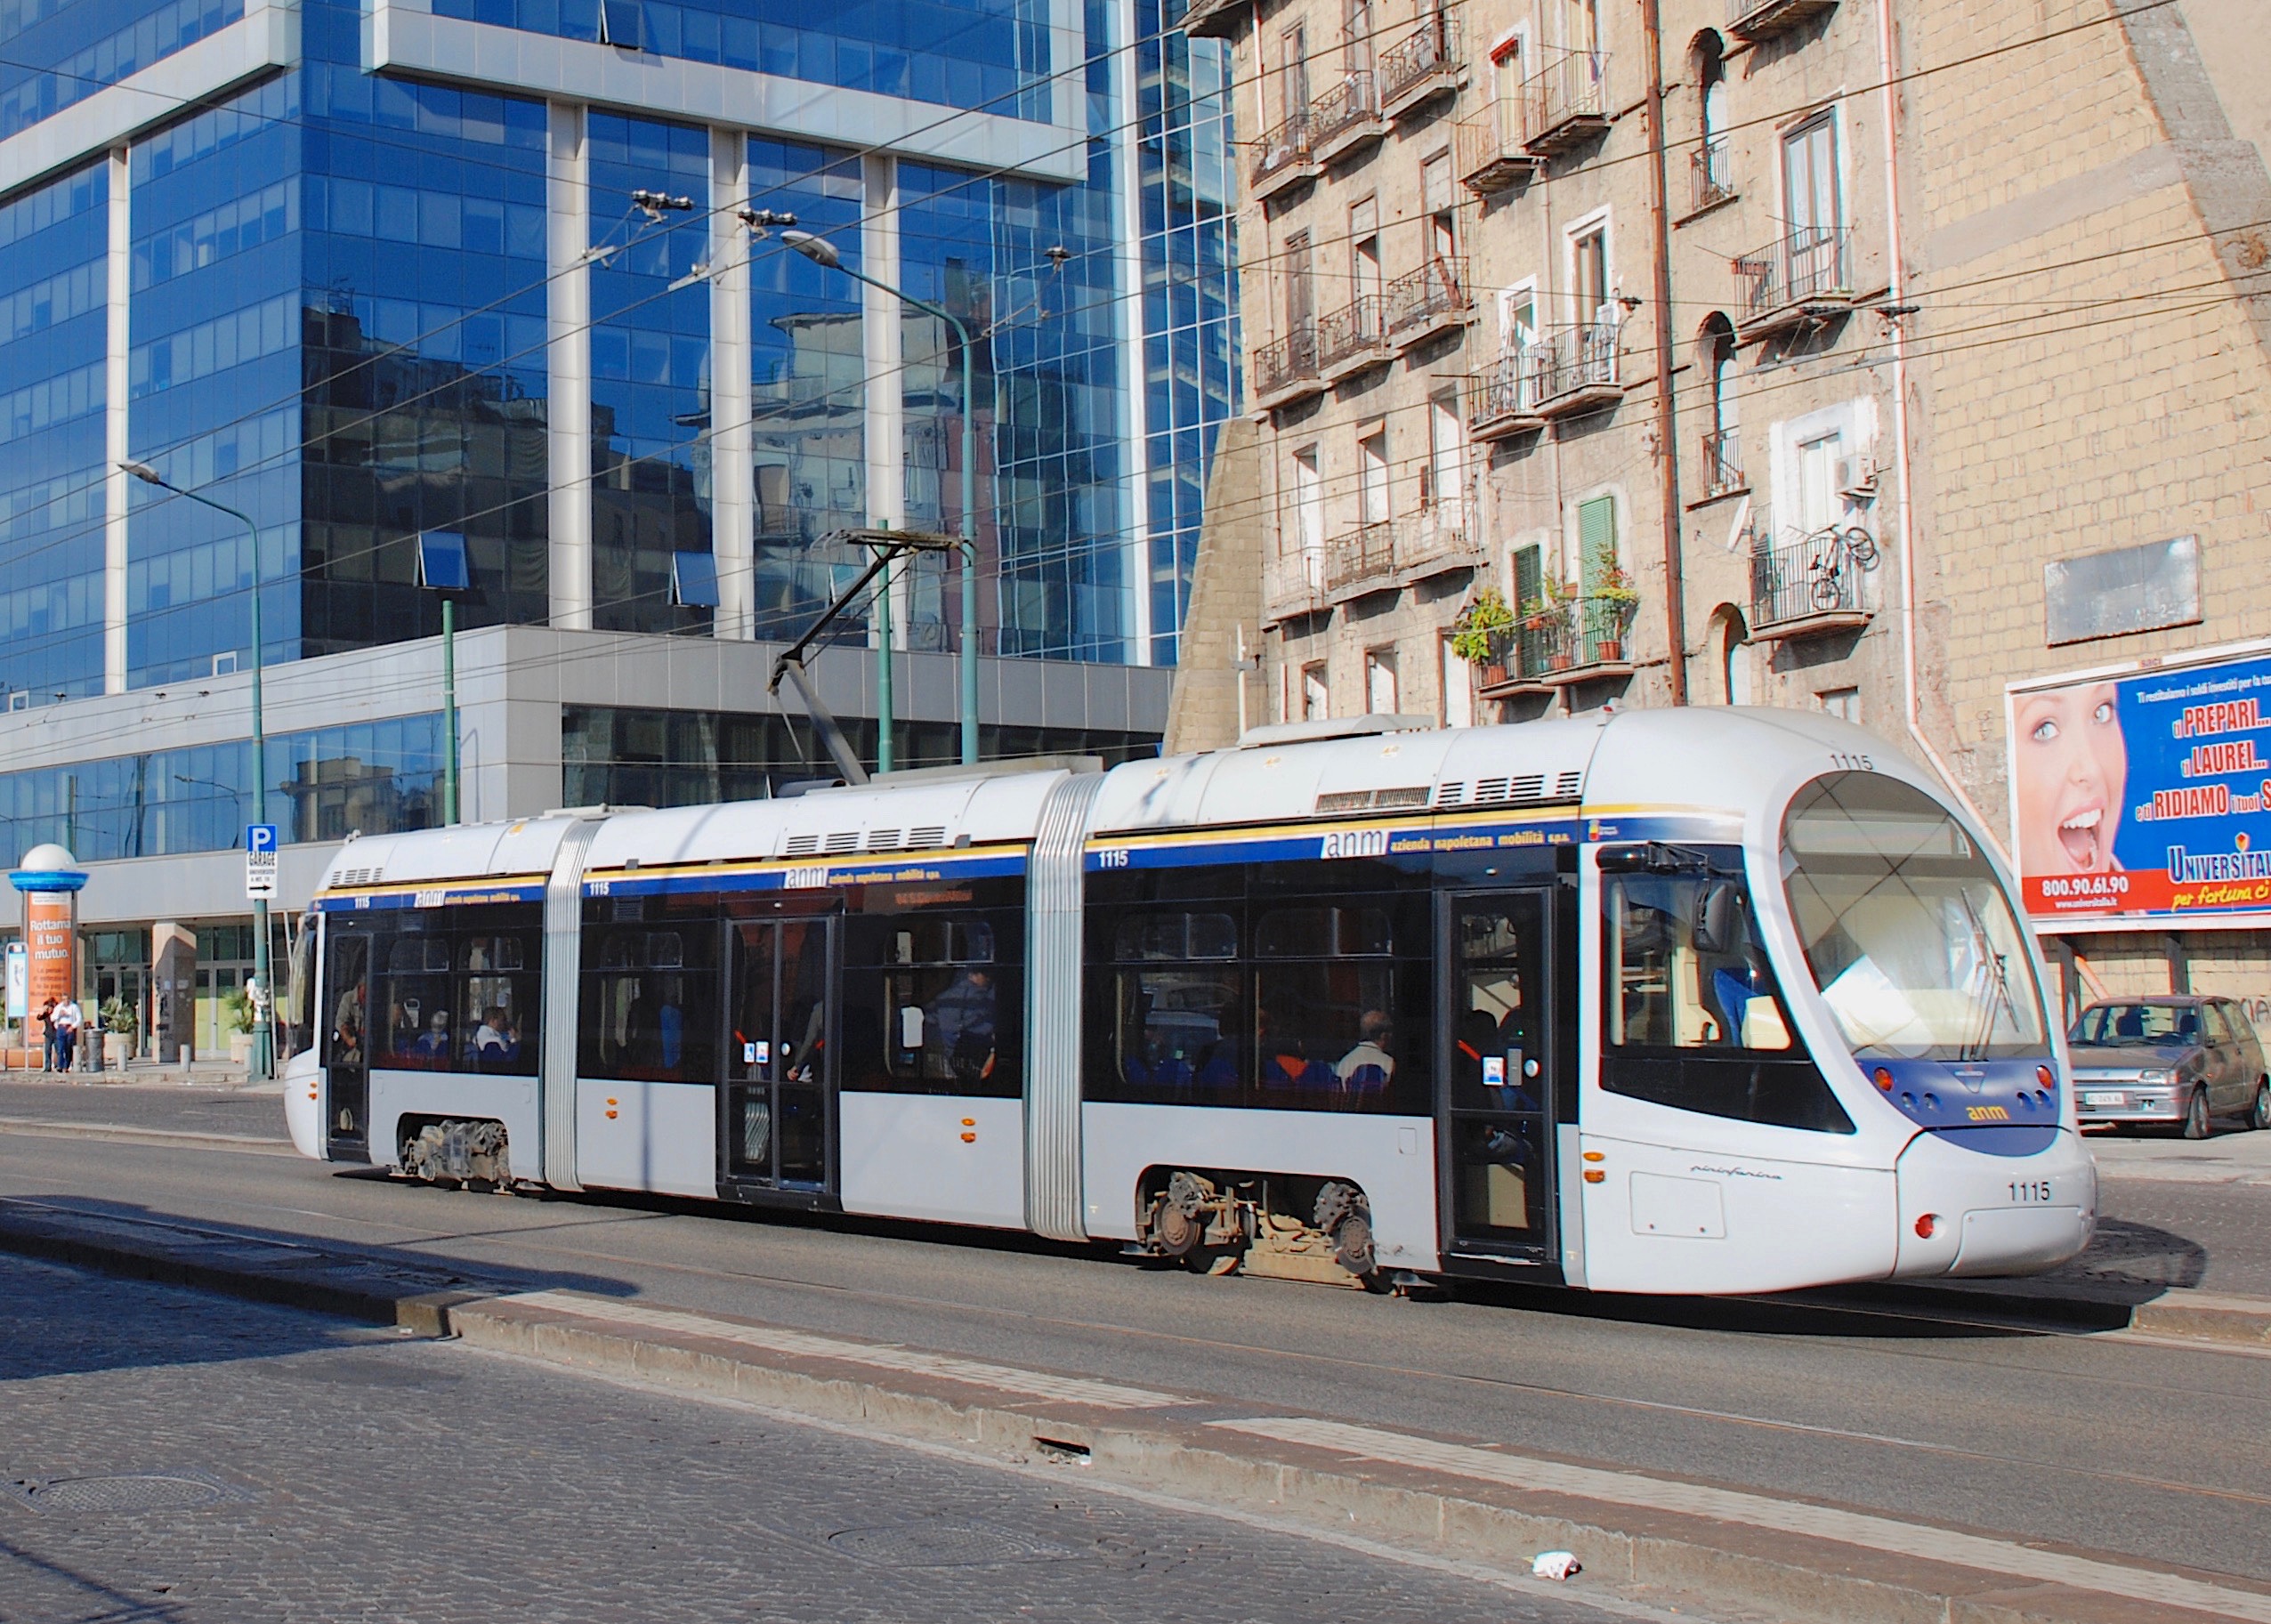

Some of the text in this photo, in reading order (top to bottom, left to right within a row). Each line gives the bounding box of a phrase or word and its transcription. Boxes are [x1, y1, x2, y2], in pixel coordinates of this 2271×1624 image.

[2183, 698, 2271, 737] PREPARI...
[1830, 753, 1873, 771] 1115
[2191, 740, 2268, 777] LAUREI...
[2153, 784, 2228, 820] RIDIAMO
[253, 827, 271, 852] P
[1327, 829, 1383, 858] anm
[1390, 836, 1431, 852] azienda
[1434, 834, 1493, 852] napoletana
[1098, 849, 1129, 869] 1115
[589, 882, 610, 896] 1115
[2041, 875, 2130, 897] 800.90.61.90
[2171, 879, 2270, 913] per fortuna ci
[354, 896, 370, 909] 1115
[36, 933, 63, 946] il tuo
[1965, 1105, 2009, 1122] anm
[2008, 1180, 2051, 1201] 1115
